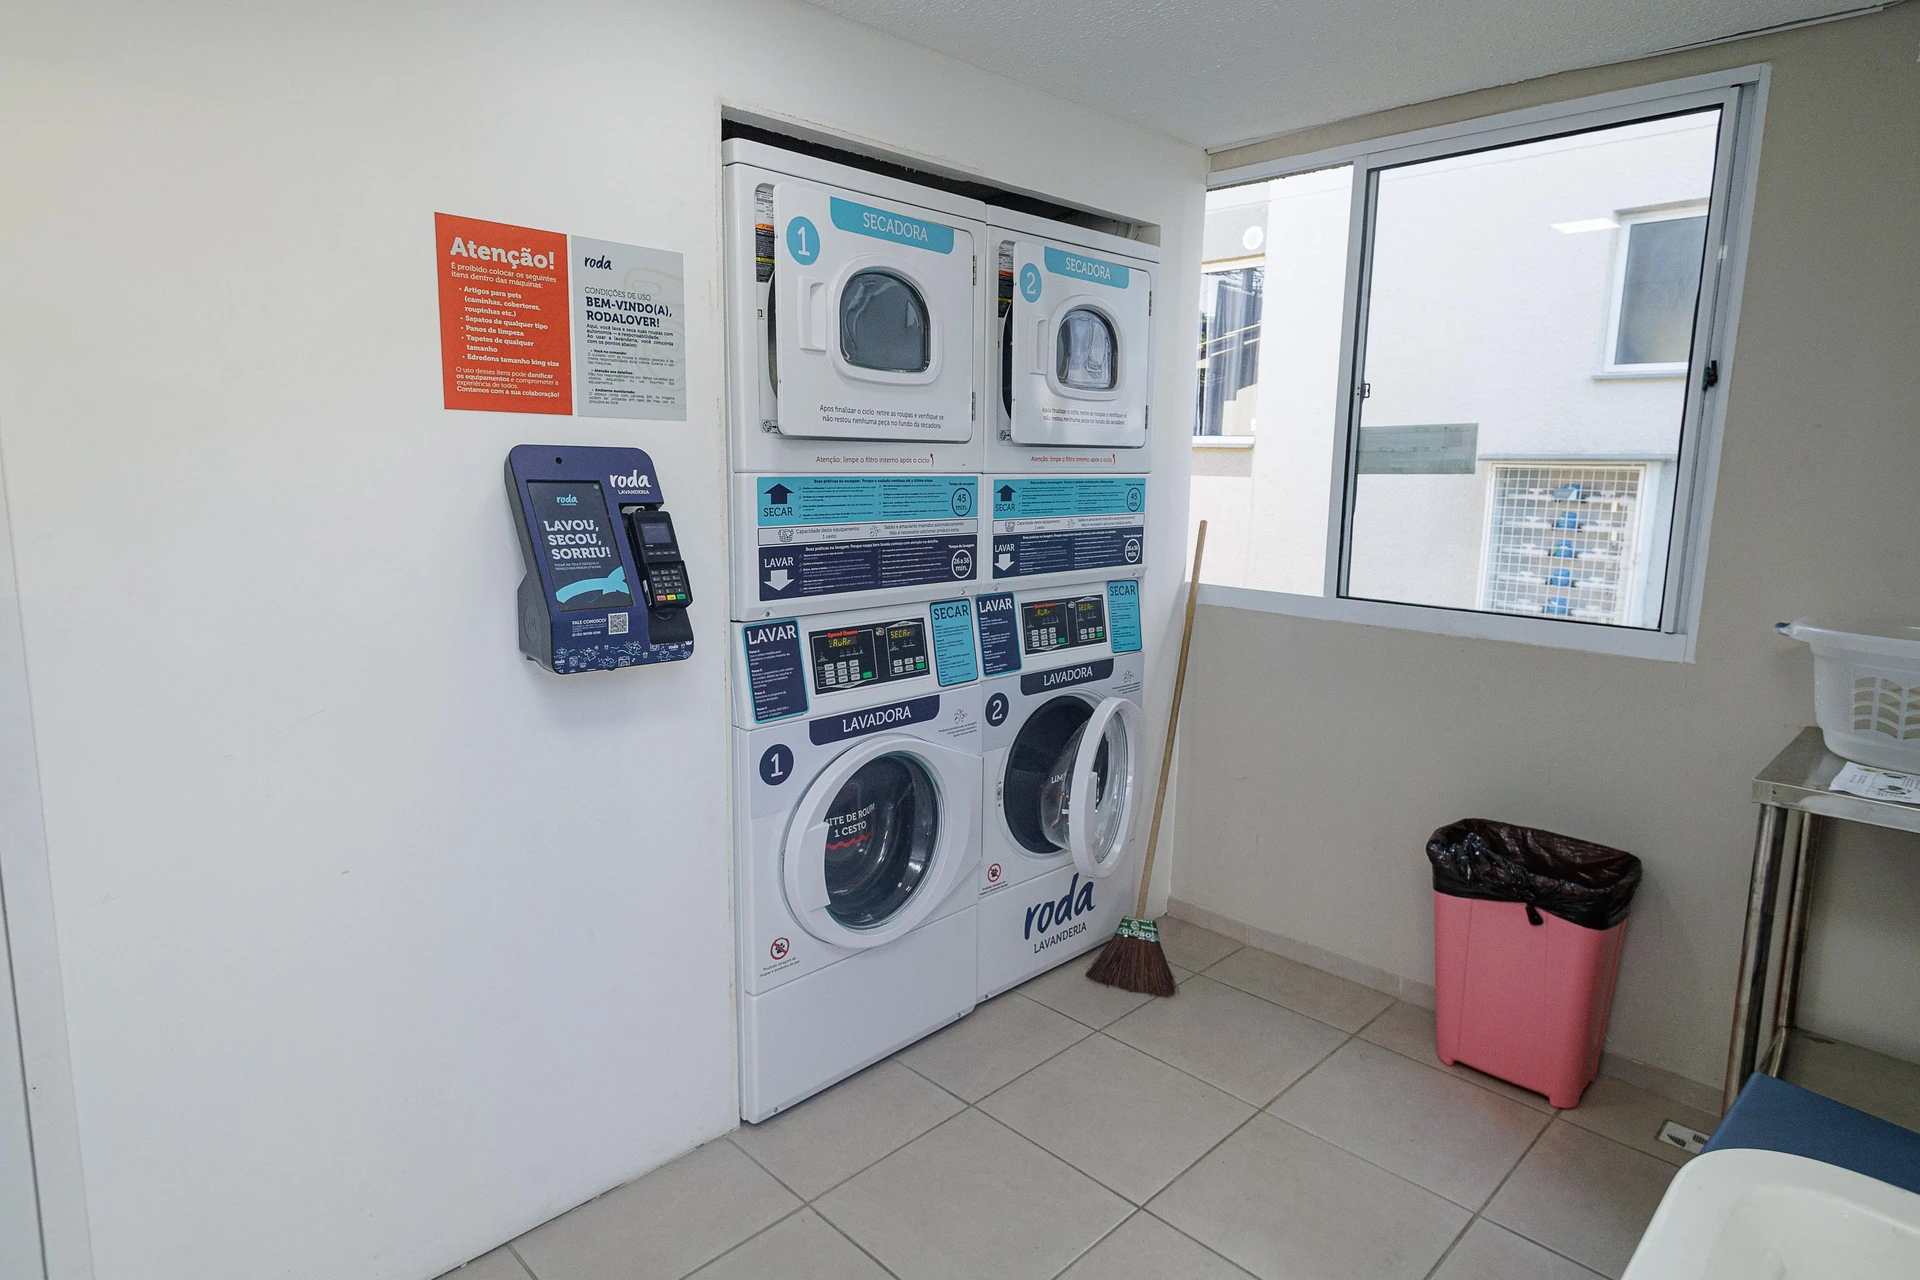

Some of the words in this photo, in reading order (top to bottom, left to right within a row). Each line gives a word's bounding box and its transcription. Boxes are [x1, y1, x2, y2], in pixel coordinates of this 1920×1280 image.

[862, 211, 928, 242] SECADORA
[797, 226, 810, 257] 1
[450, 236, 555, 270] Atenção!
[584, 255, 612, 270] roda
[1065, 257, 1111, 280] SECADORA
[451, 261, 456, 269] É
[457, 262, 488, 273] proibido
[489, 268, 514, 278] colocar
[525, 273, 557, 283] seguintes
[451, 270, 469, 279] itens
[470, 272, 494, 282] dentro
[495, 276, 507, 284] das
[508, 278, 544, 289] máquinas:
[1027, 271, 1036, 295] 2
[464, 286, 489, 297] Artigos
[490, 290, 507, 298] para
[507, 291, 522, 299] pets
[585, 286, 626, 298] CONDIÇÕES
[627, 291, 636, 299] DE
[637, 293, 651, 301] USO
[464, 295, 503, 306] (caminhas,
[504, 301, 541, 311] cobertores,
[586, 296, 673, 317] BEM-VINDO(A),
[464, 306, 500, 316] roupinhas
[501, 310, 517, 318] etc.)
[586, 310, 660, 328] RODALOVER!
[465, 315, 492, 325] Sapatos
[503, 320, 534, 329] qualquer
[534, 322, 549, 331] tipo
[466, 324, 487, 333] Panos
[498, 327, 524, 337] limpeza
[466, 334, 493, 344] Tapetes
[504, 339, 535, 347] qualquer
[466, 344, 498, 353] tamanho
[467, 353, 500, 363] Edredons
[500, 357, 530, 365] tamanho
[531, 359, 546, 367] king
[465, 374, 509, 382] equipamentos
[515, 378, 554, 386] comprometer
[527, 371, 553, 379] danificar
[522, 389, 560, 398] colaboração!
[835, 405, 856, 414] finalizar
[876, 409, 890, 417] retire
[897, 412, 913, 420] roupas
[918, 413, 938, 421] verifique
[852, 417, 877, 425] nenhuma
[878, 419, 890, 427] peça
[816, 455, 843, 464] Atenção:
[843, 456, 859, 464] limpe
[609, 469, 652, 489] roda
[556, 494, 578, 504] roda
[957, 494, 967, 503] 45
[763, 507, 793, 517] SECAR
[995, 503, 1016, 512] SECAR
[543, 520, 599, 532] LAVOU,
[547, 533, 602, 546] SECOU,
[551, 547, 612, 560] SORRIU!
[994, 543, 1015, 553] LAVAR
[764, 557, 794, 568] LAVAR
[1110, 585, 1136, 596] SECAR
[933, 604, 969, 620] SECAR
[978, 598, 1013, 613] LAVAR
[746, 625, 797, 645] LAVAR
[1043, 666, 1093, 686] LAVADORA
[992, 699, 1003, 721] 2
[843, 706, 912, 733] LAVADORA
[770, 753, 784, 778] 1
[846, 812, 857, 823] DE
[834, 829, 840, 838] 1
[841, 820, 867, 836] CESTO
[1024, 872, 1096, 940] roda
[1033, 922, 1087, 954] LAVANDERIA
